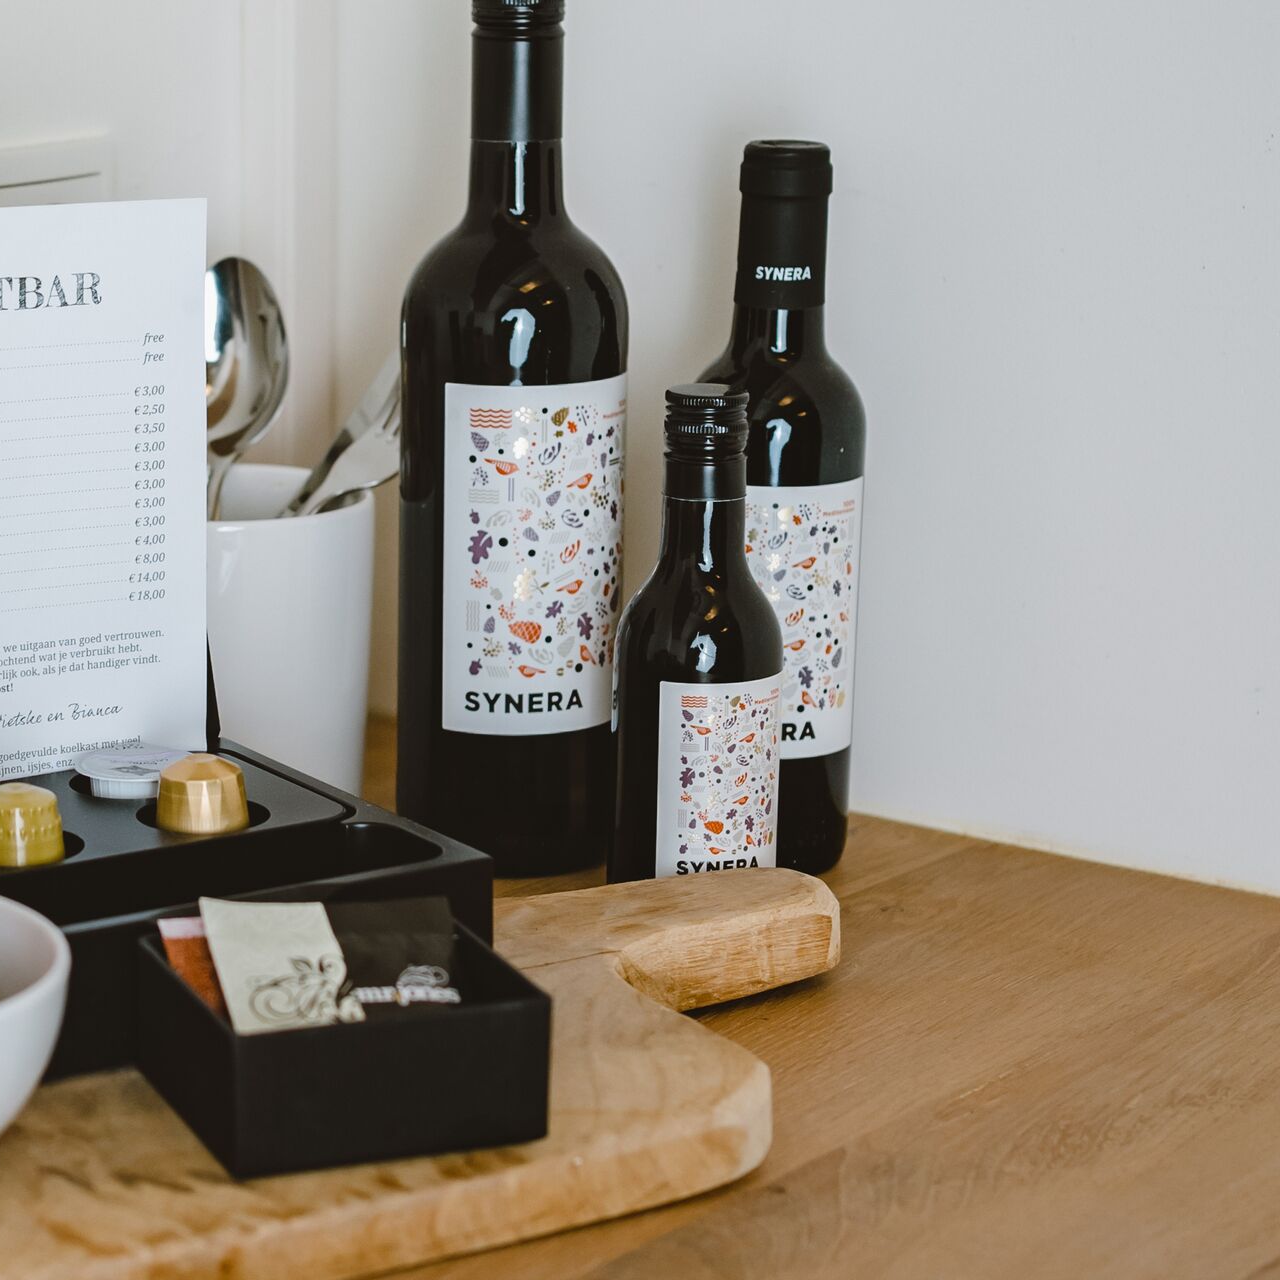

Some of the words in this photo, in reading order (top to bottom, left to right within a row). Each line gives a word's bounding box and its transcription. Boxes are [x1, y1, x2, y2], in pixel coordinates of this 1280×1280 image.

[755, 265, 812, 281] SYNERA
[142, 332, 165, 346] free
[142, 351, 165, 366] free
[2, 643, 18, 653] we
[20, 640, 56, 652] uitgaan
[58, 637, 77, 648] van
[78, 633, 102, 647] goed
[104, 628, 165, 644] vertrouwen.
[38, 652, 56, 662] wat
[58, 650, 68, 662] je
[70, 644, 116, 658] verbruikt
[42, 664, 56, 675] als
[58, 664, 67, 676] je
[69, 660, 85, 672] dat
[86, 656, 131, 670] handiger
[464, 688, 583, 714] SYNERA
[46, 711, 64, 723] en
[67, 702, 124, 720] Bianca
[60, 740, 99, 755] koelkast
[101, 738, 119, 750] met
